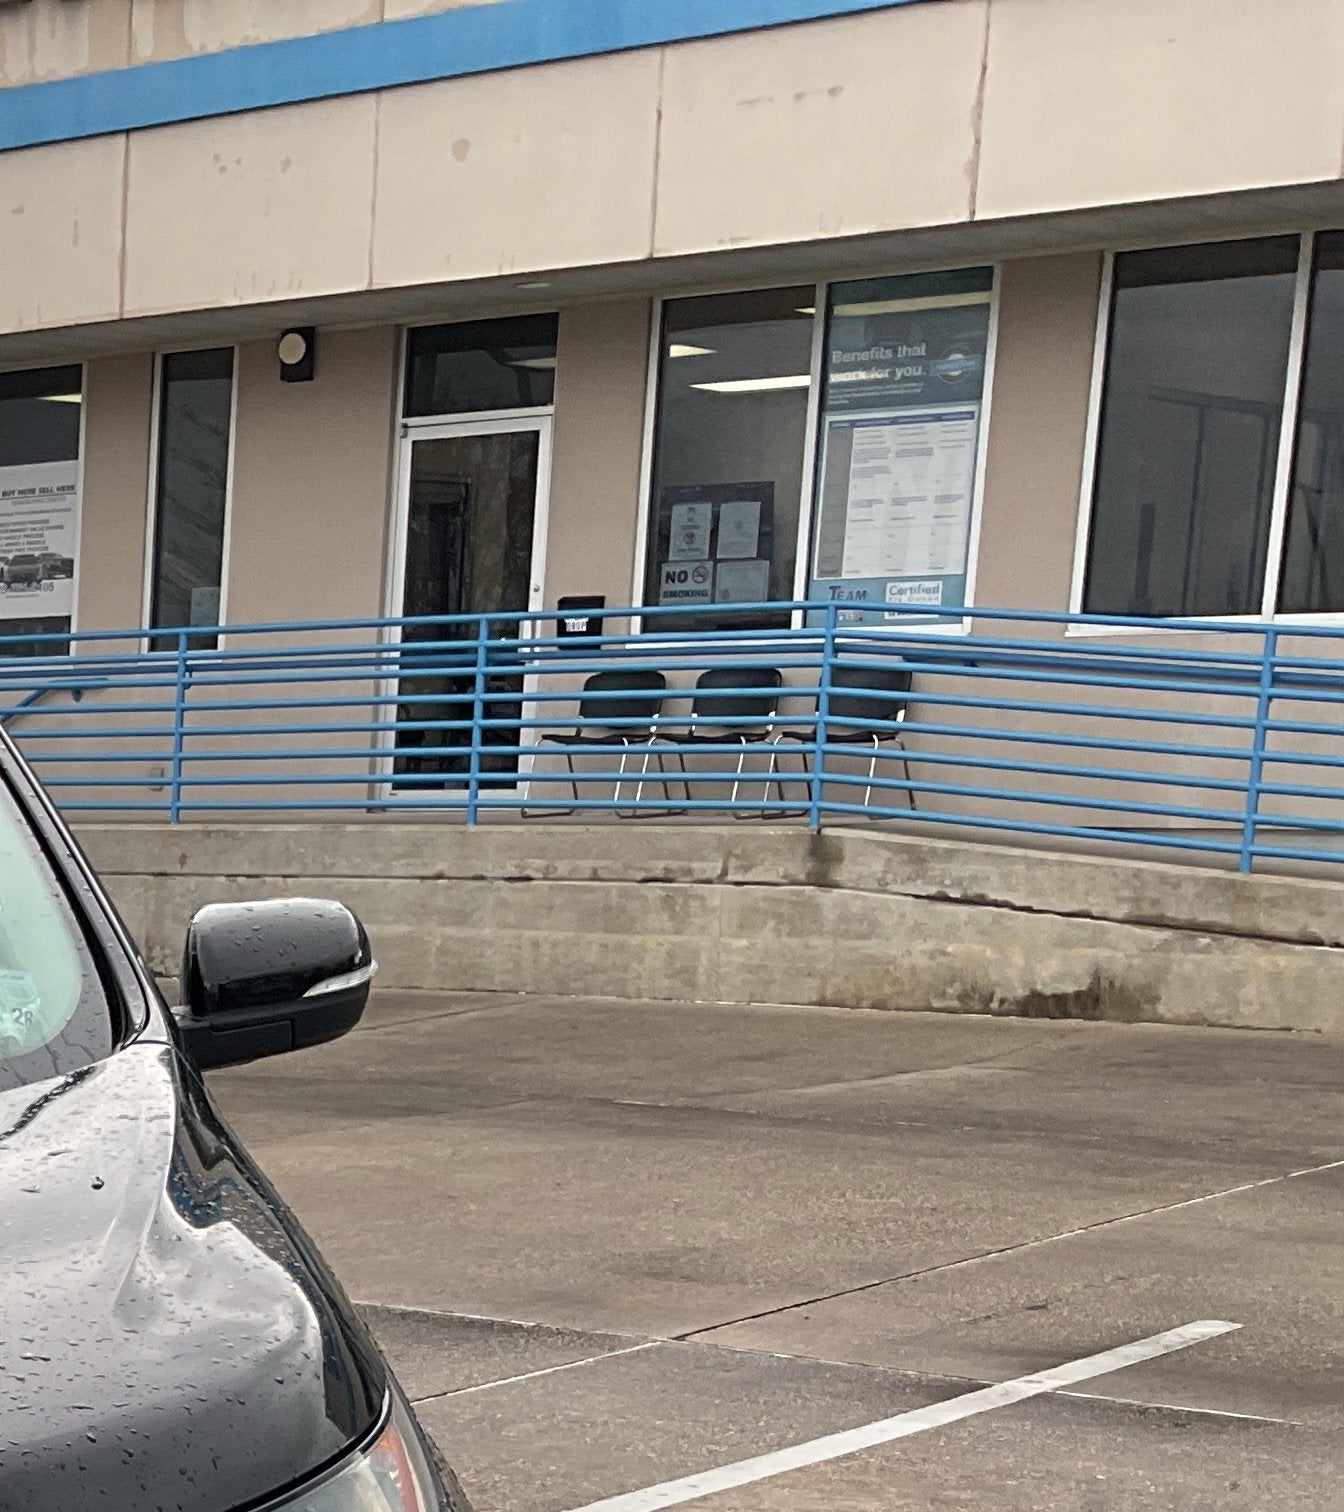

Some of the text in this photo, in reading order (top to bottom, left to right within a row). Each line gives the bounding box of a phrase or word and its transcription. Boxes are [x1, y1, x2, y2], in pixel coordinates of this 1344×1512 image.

[832, 342, 927, 363] Benefits that
[665, 570, 689, 584] NO
[662, 589, 709, 599] SMOKING
[829, 585, 868, 601] TEAM
[888, 583, 941, 596] Certified
